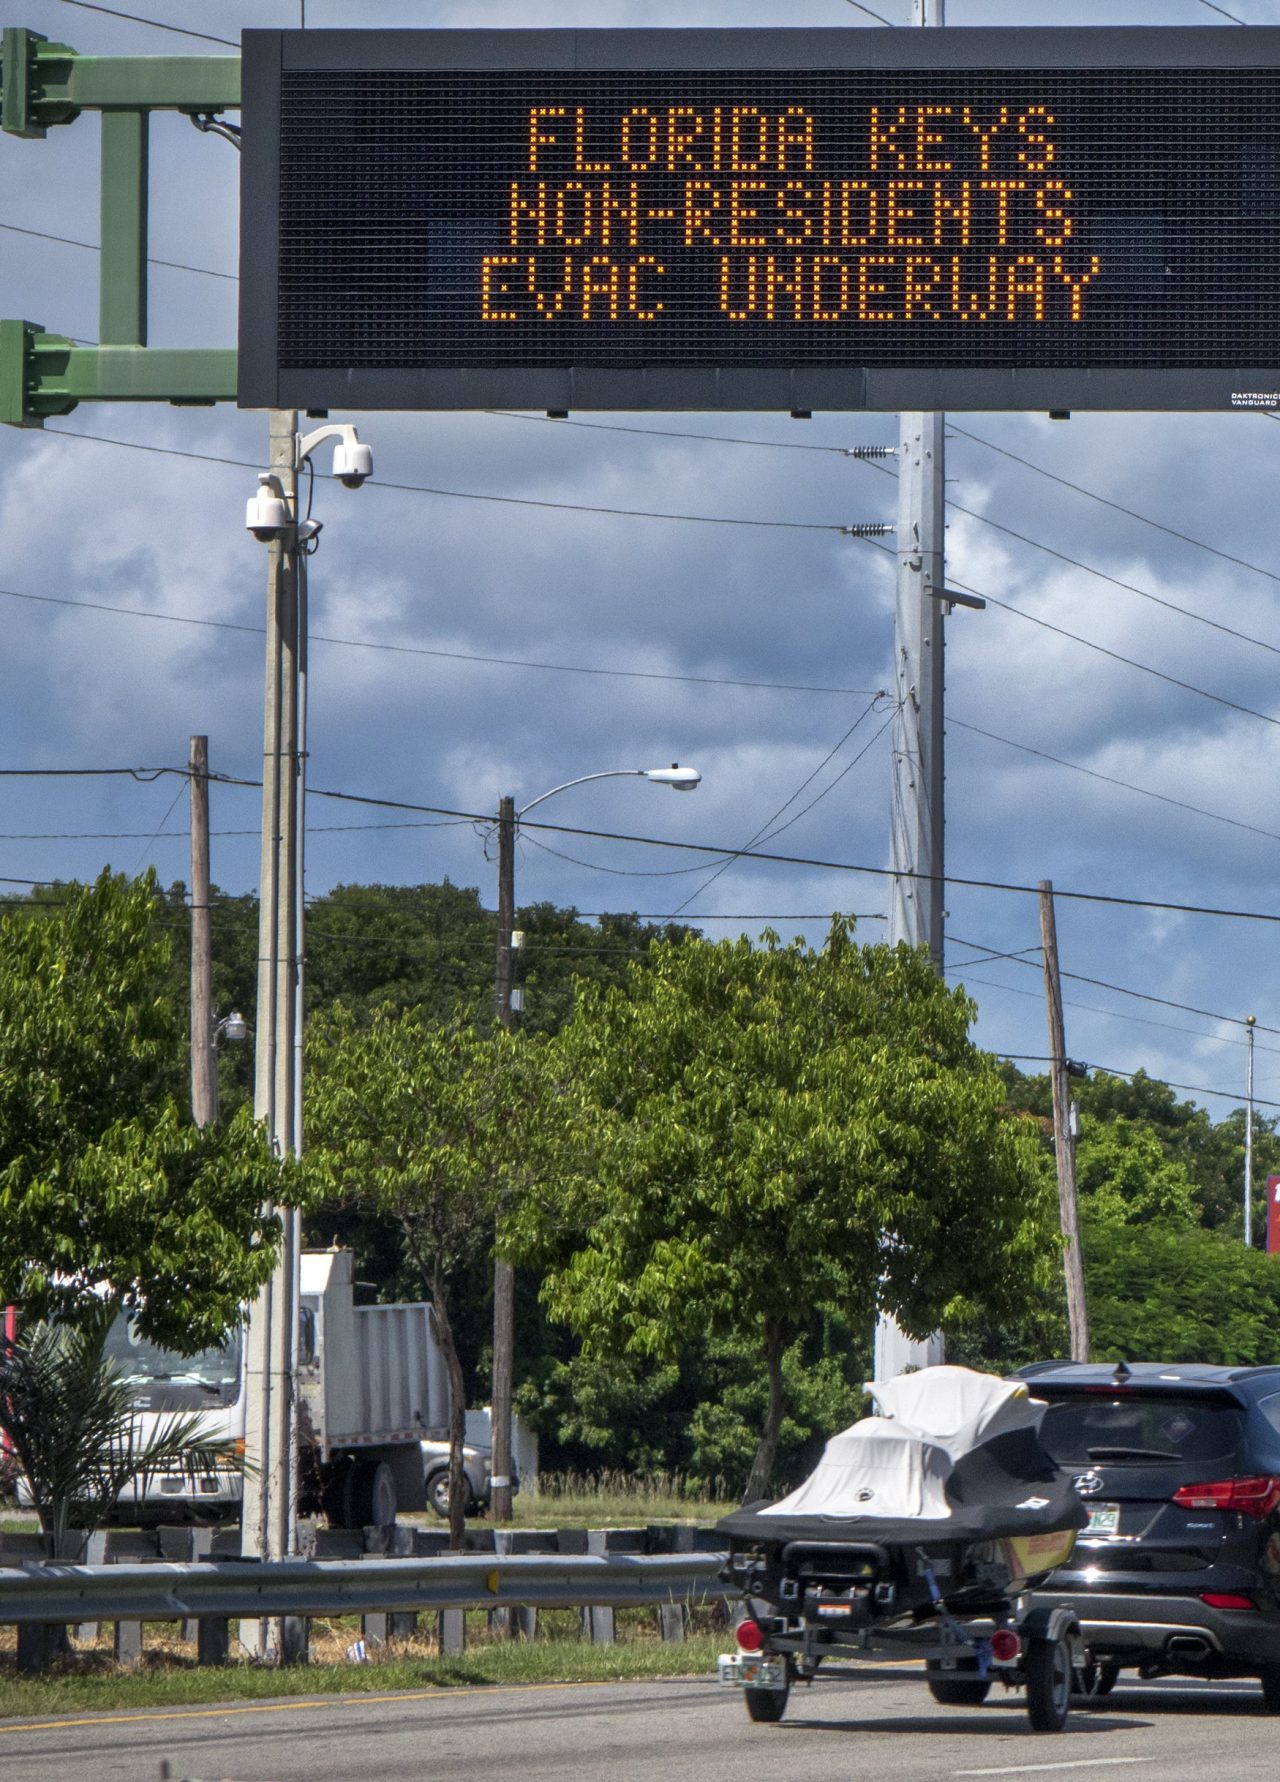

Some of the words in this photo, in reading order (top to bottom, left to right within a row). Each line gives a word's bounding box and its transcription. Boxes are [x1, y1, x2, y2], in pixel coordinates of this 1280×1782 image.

[529, 106, 813, 171] FLORIDA
[870, 106, 1054, 171] KEYS
[510, 181, 1072, 246] NON-RESIDENTS
[481, 256, 665, 320] EVAC
[720, 256, 1099, 320] UNDERWAY
